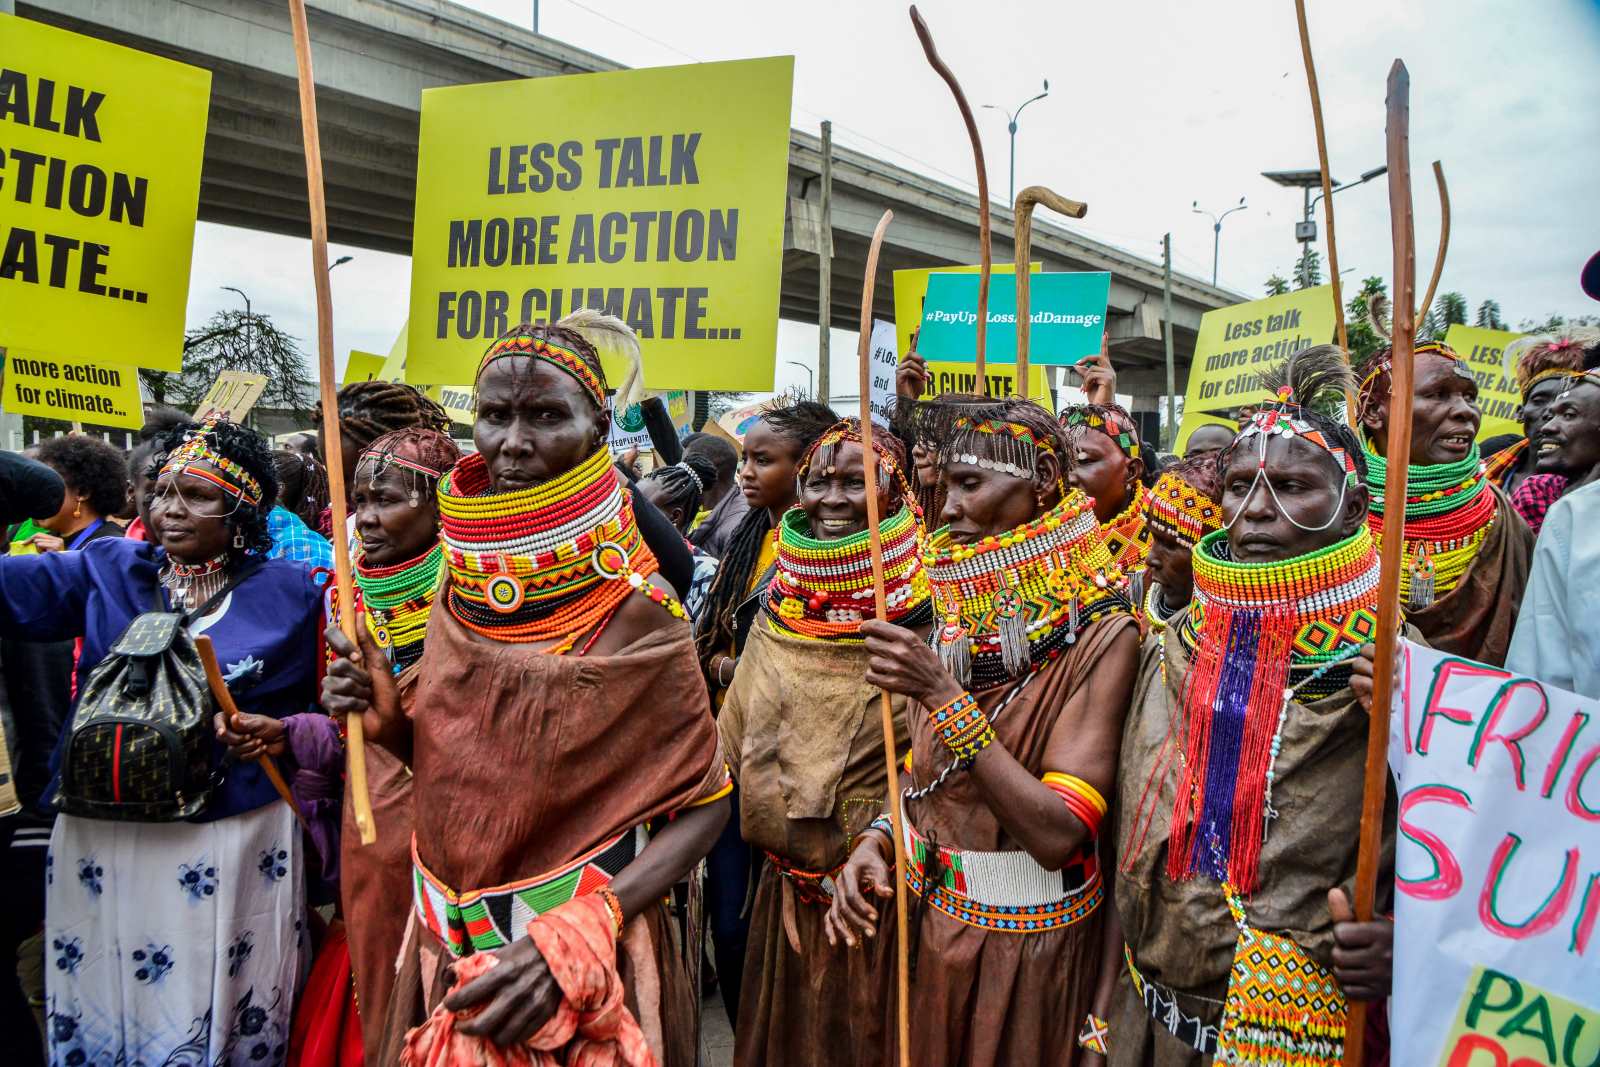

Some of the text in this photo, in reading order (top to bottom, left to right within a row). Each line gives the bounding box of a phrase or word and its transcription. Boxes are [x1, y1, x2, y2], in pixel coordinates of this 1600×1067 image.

[487, 132, 703, 196] LESS TALK
[0, 146, 148, 228] TION
[447, 208, 739, 268] MORE ACTION
[436, 289, 510, 340] FOR
[1223, 308, 1302, 342] Less talk
[1204, 337, 1313, 372] more action
[12, 357, 121, 387] more action
[873, 375, 890, 391] and
[940, 371, 1013, 398] CLIMATE
[15, 383, 127, 416] for climate...
[1198, 380, 1223, 400] for
